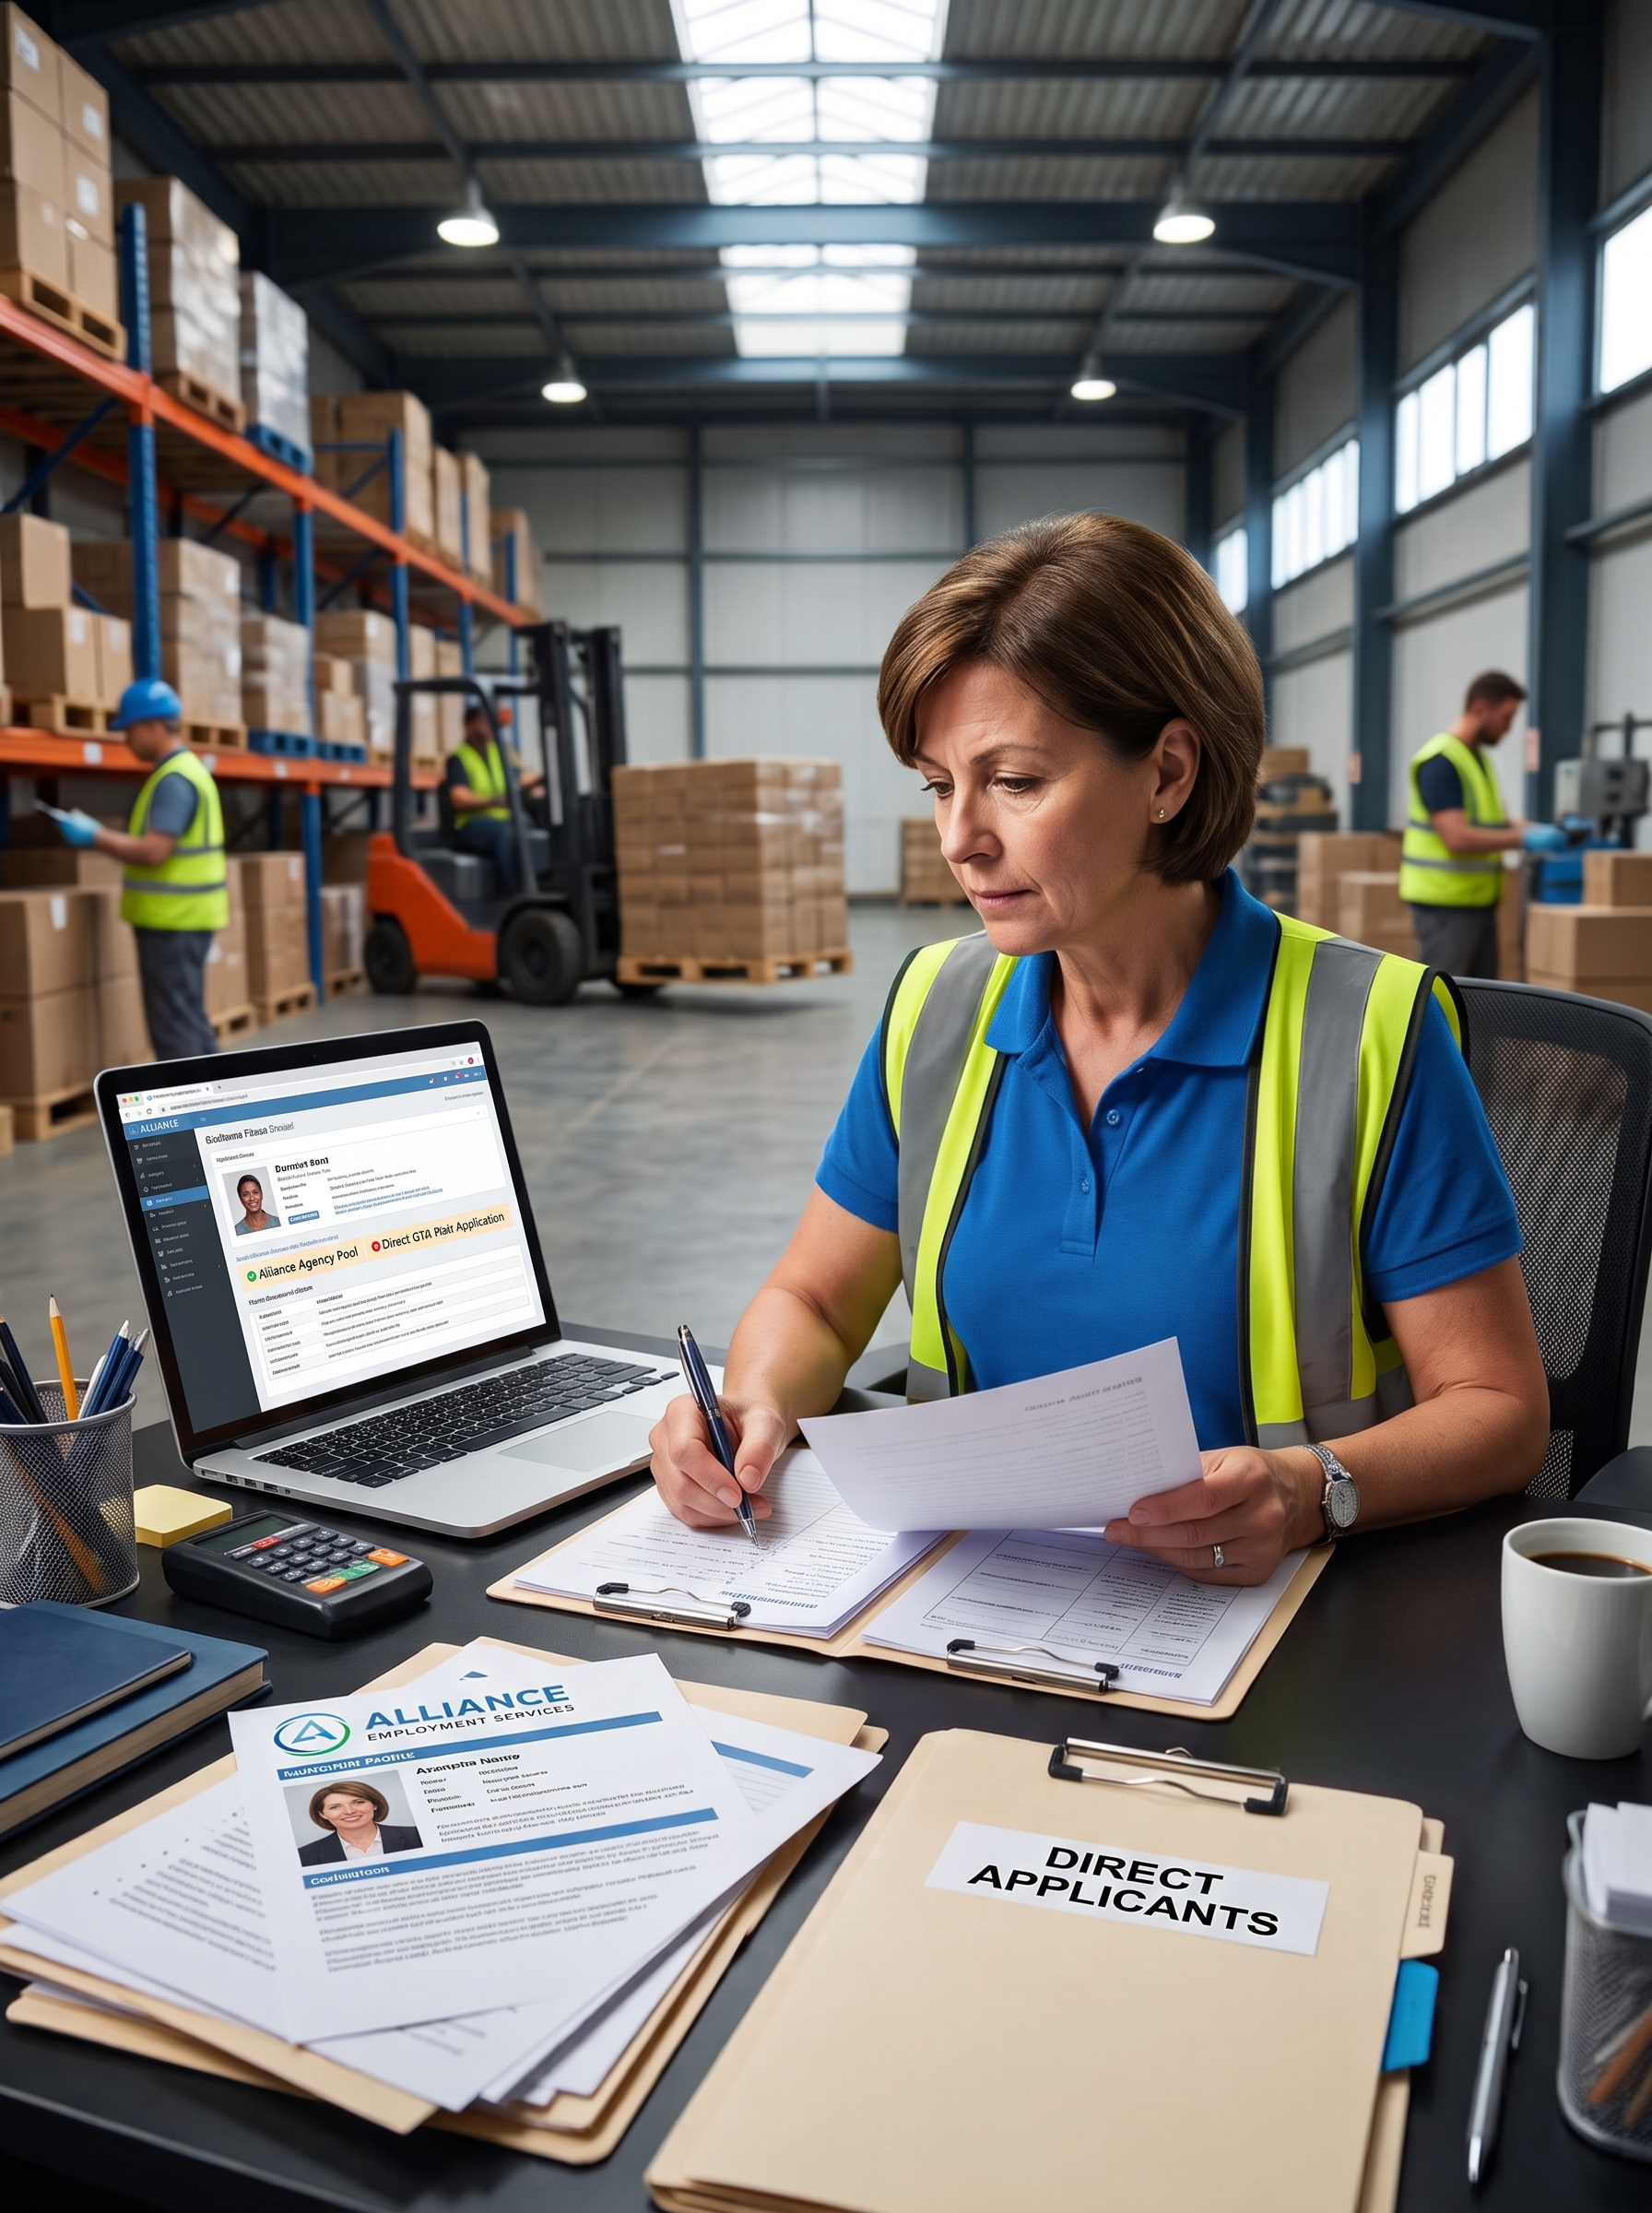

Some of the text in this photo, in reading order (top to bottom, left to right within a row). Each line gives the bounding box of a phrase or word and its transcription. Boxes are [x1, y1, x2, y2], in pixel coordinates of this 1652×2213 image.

[140, 1118, 179, 1133] ALLIANCE
[382, 1235, 411, 1249] Direct
[412, 1229, 432, 1242] GTA
[456, 1213, 504, 1232] Application
[299, 1254, 335, 1271] Agency
[336, 1246, 359, 1260] Pool
[365, 1685, 570, 1730] ALLIANCE
[367, 1704, 574, 1741] EMPLOYMENT SERVICES
[1044, 1846, 1224, 1895] DIRECT
[967, 1864, 1280, 1936] APPLICANTS
